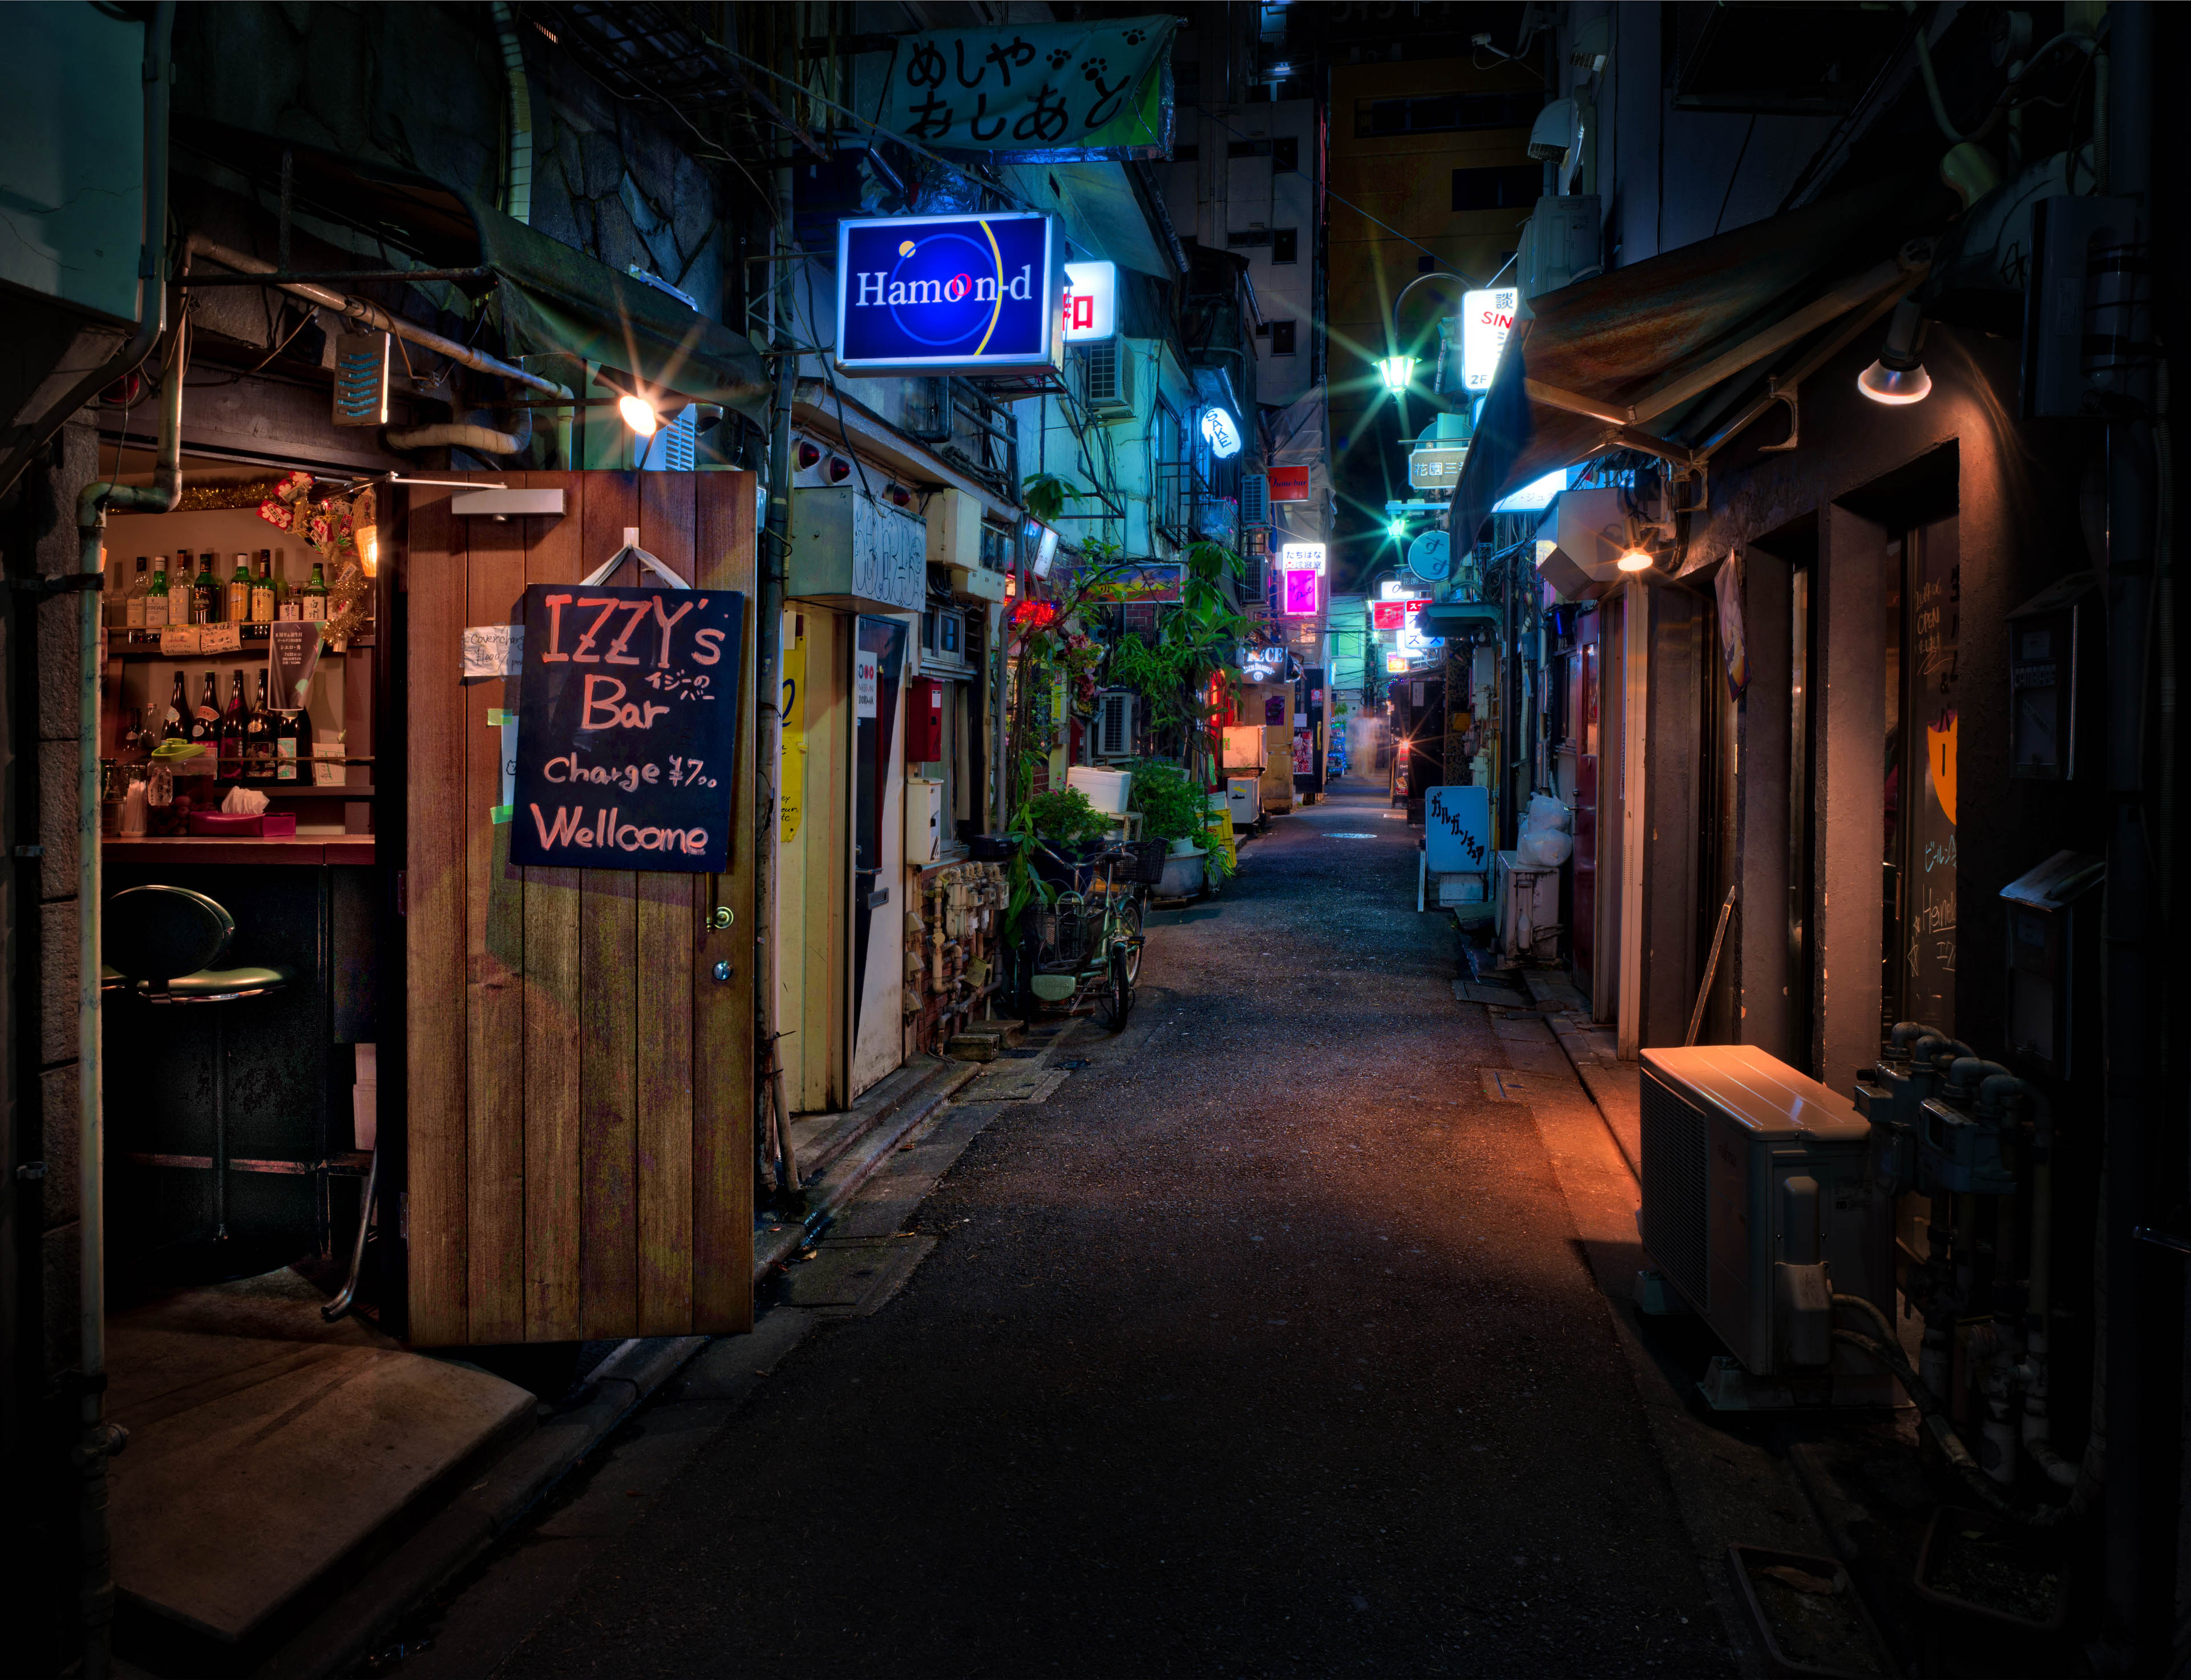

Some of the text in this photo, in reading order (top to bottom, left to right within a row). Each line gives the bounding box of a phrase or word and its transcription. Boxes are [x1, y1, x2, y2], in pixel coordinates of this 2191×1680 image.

[907, 35, 1036, 90] めしや
[1495, 292, 1513, 309] 談
[1470, 374, 1488, 385] 2F
[1205, 410, 1232, 449] SAKE
[543, 594, 726, 668] IZZY's
[581, 673, 670, 730] Bar
[544, 752, 660, 793] Charge
[529, 802, 709, 855] Wellcome
[1431, 791, 1484, 866] ガルガンチュア
